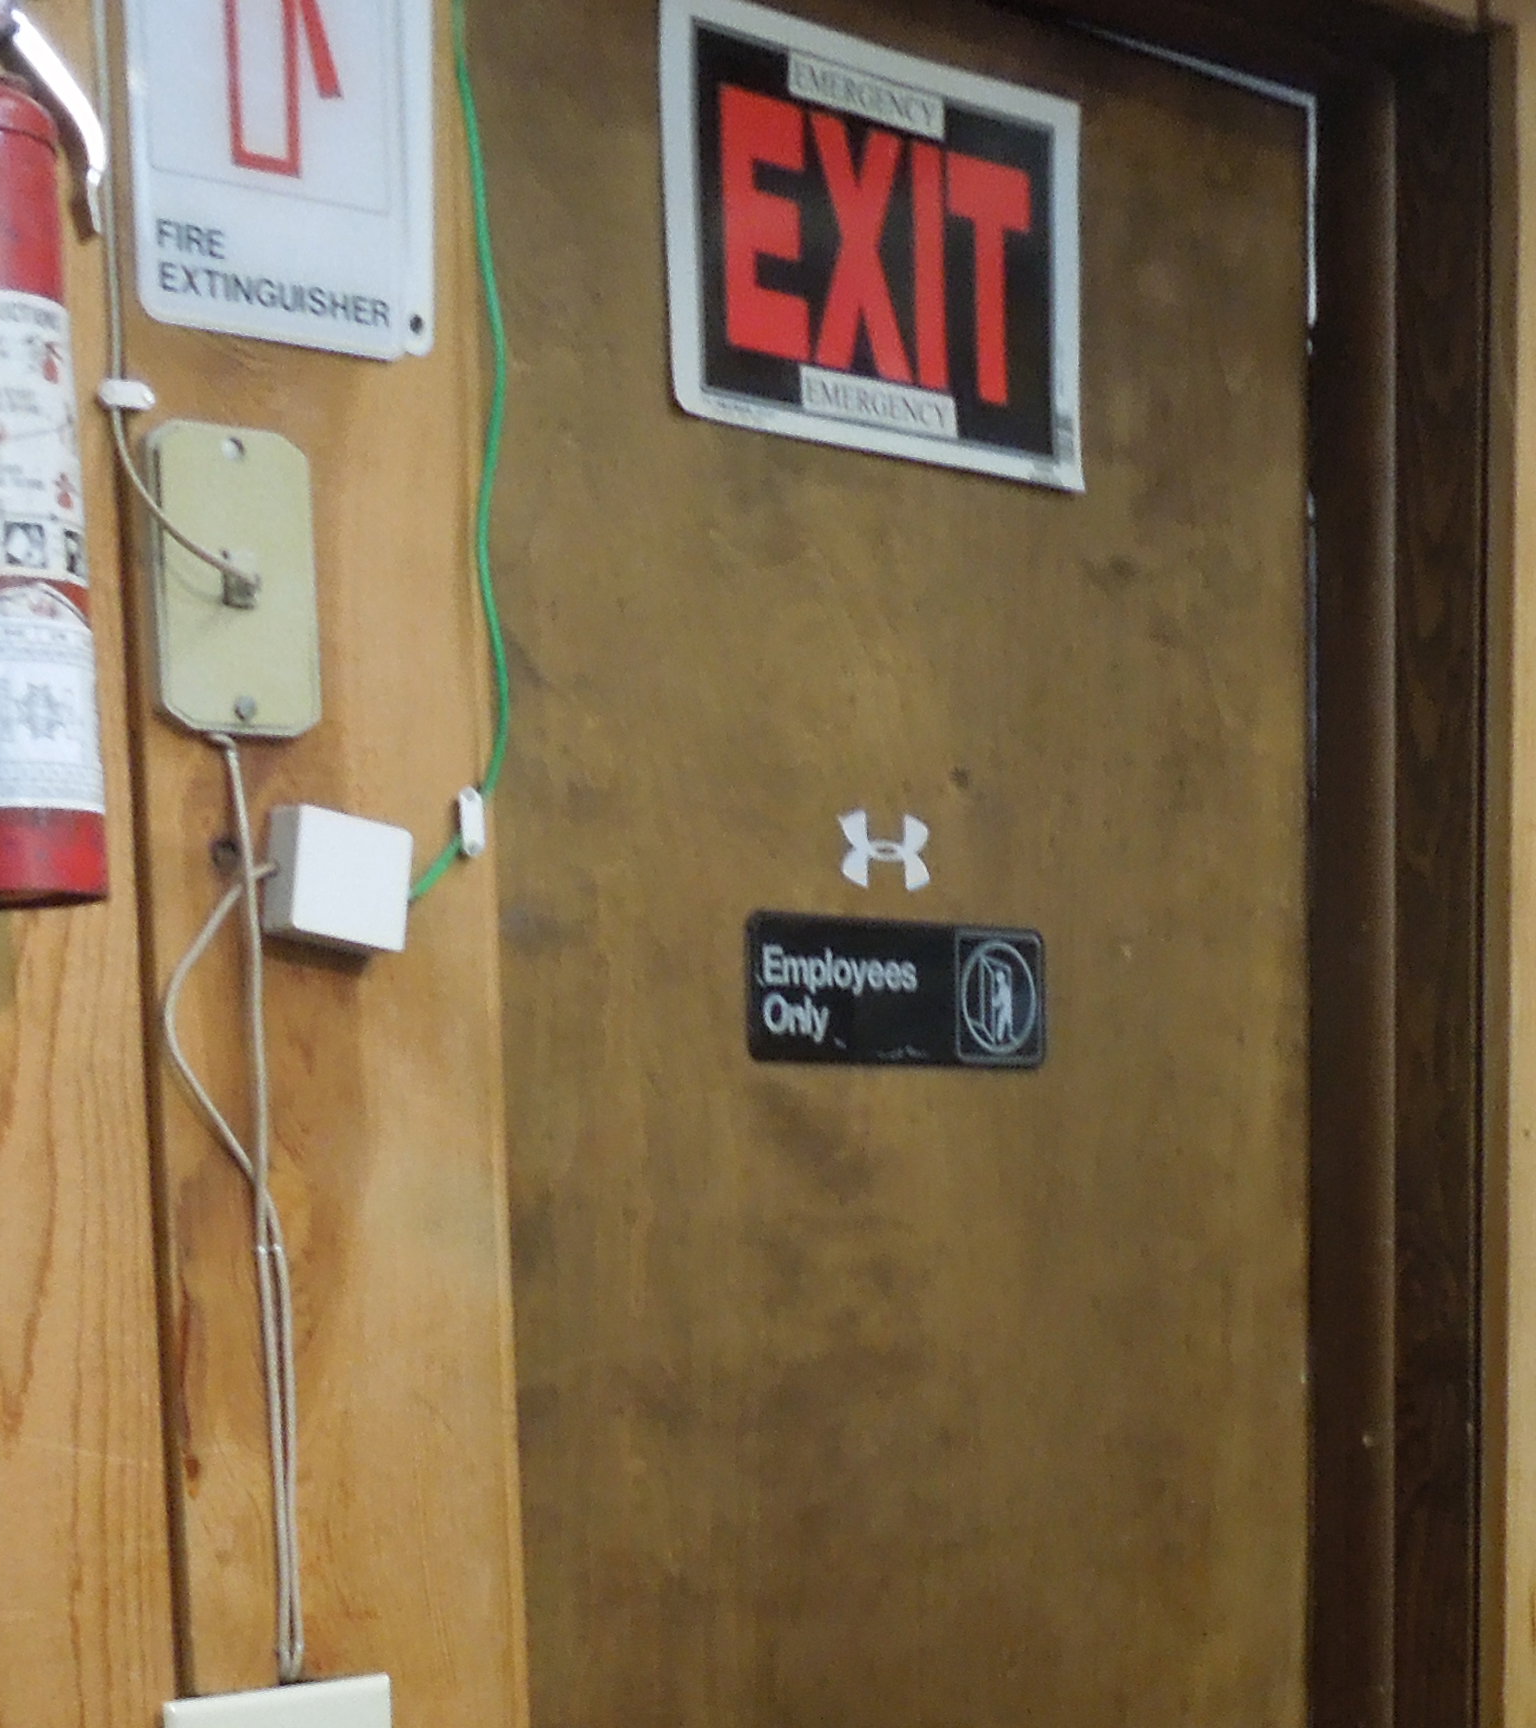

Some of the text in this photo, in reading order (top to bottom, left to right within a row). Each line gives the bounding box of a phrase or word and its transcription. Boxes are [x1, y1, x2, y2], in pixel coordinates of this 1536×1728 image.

[795, 61, 937, 133] EMERGENCY
[156, 218, 225, 260] FIRE
[718, 84, 1032, 407] EXIT
[157, 261, 391, 328] EXTINGUISHER
[809, 376, 952, 430] EMERGENCY
[761, 944, 918, 996] Employees
[762, 993, 831, 1043] Only
